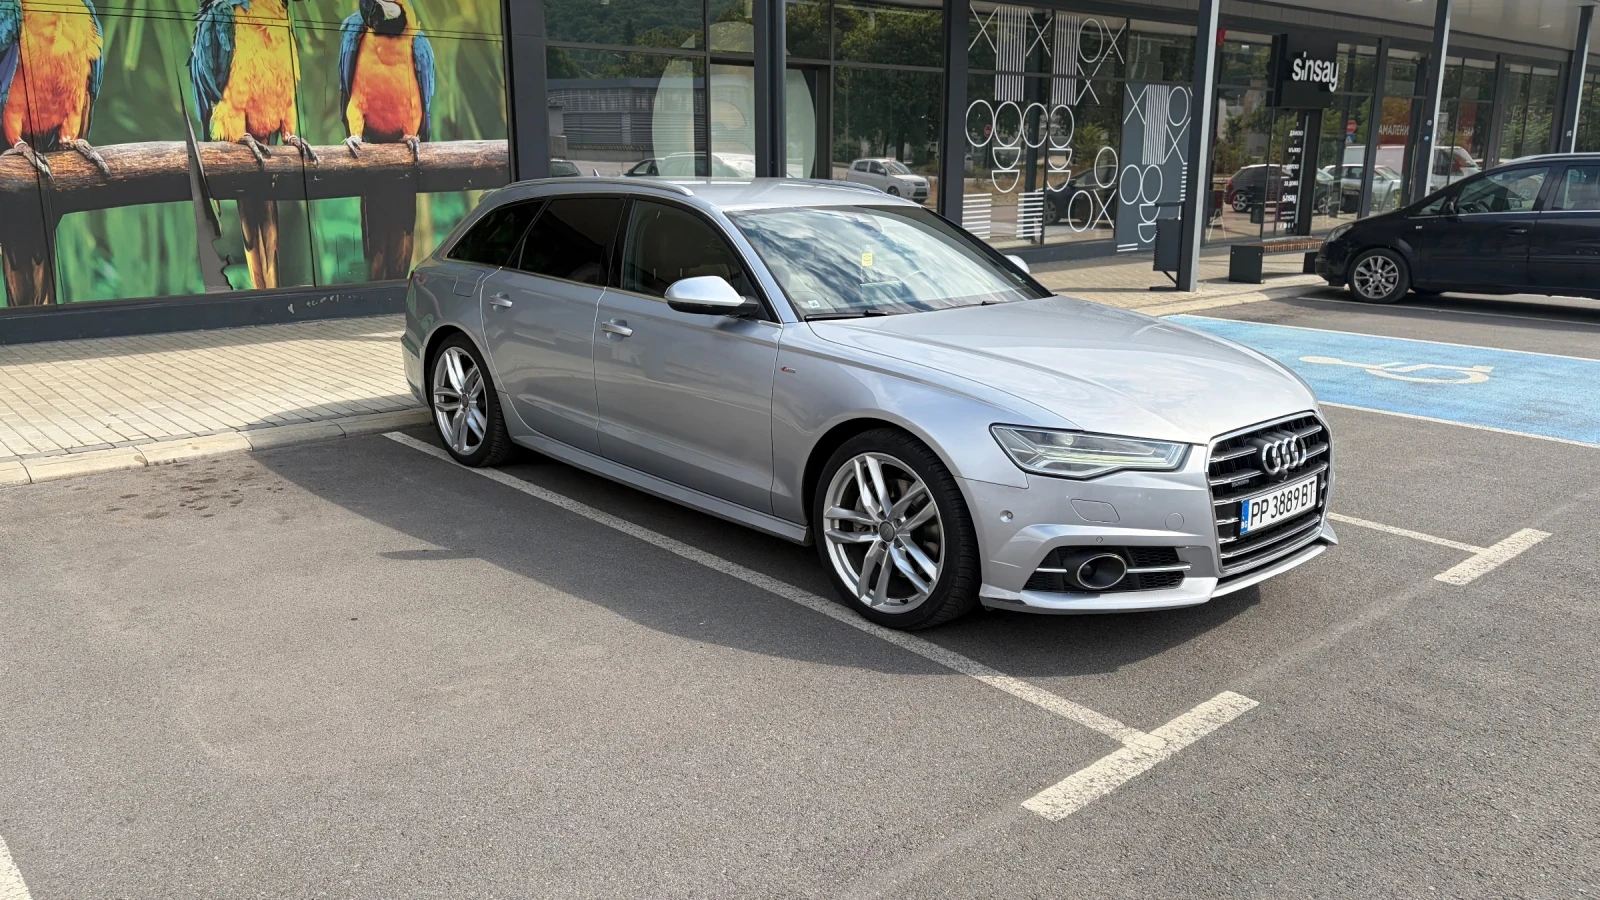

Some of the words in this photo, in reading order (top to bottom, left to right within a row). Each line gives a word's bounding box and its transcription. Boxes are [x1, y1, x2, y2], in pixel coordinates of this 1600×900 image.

[1292, 51, 1339, 92] sinsay
[1251, 499, 1269, 526] PP
[1271, 488, 1300, 518] 3889
[1301, 480, 1315, 507] BT
